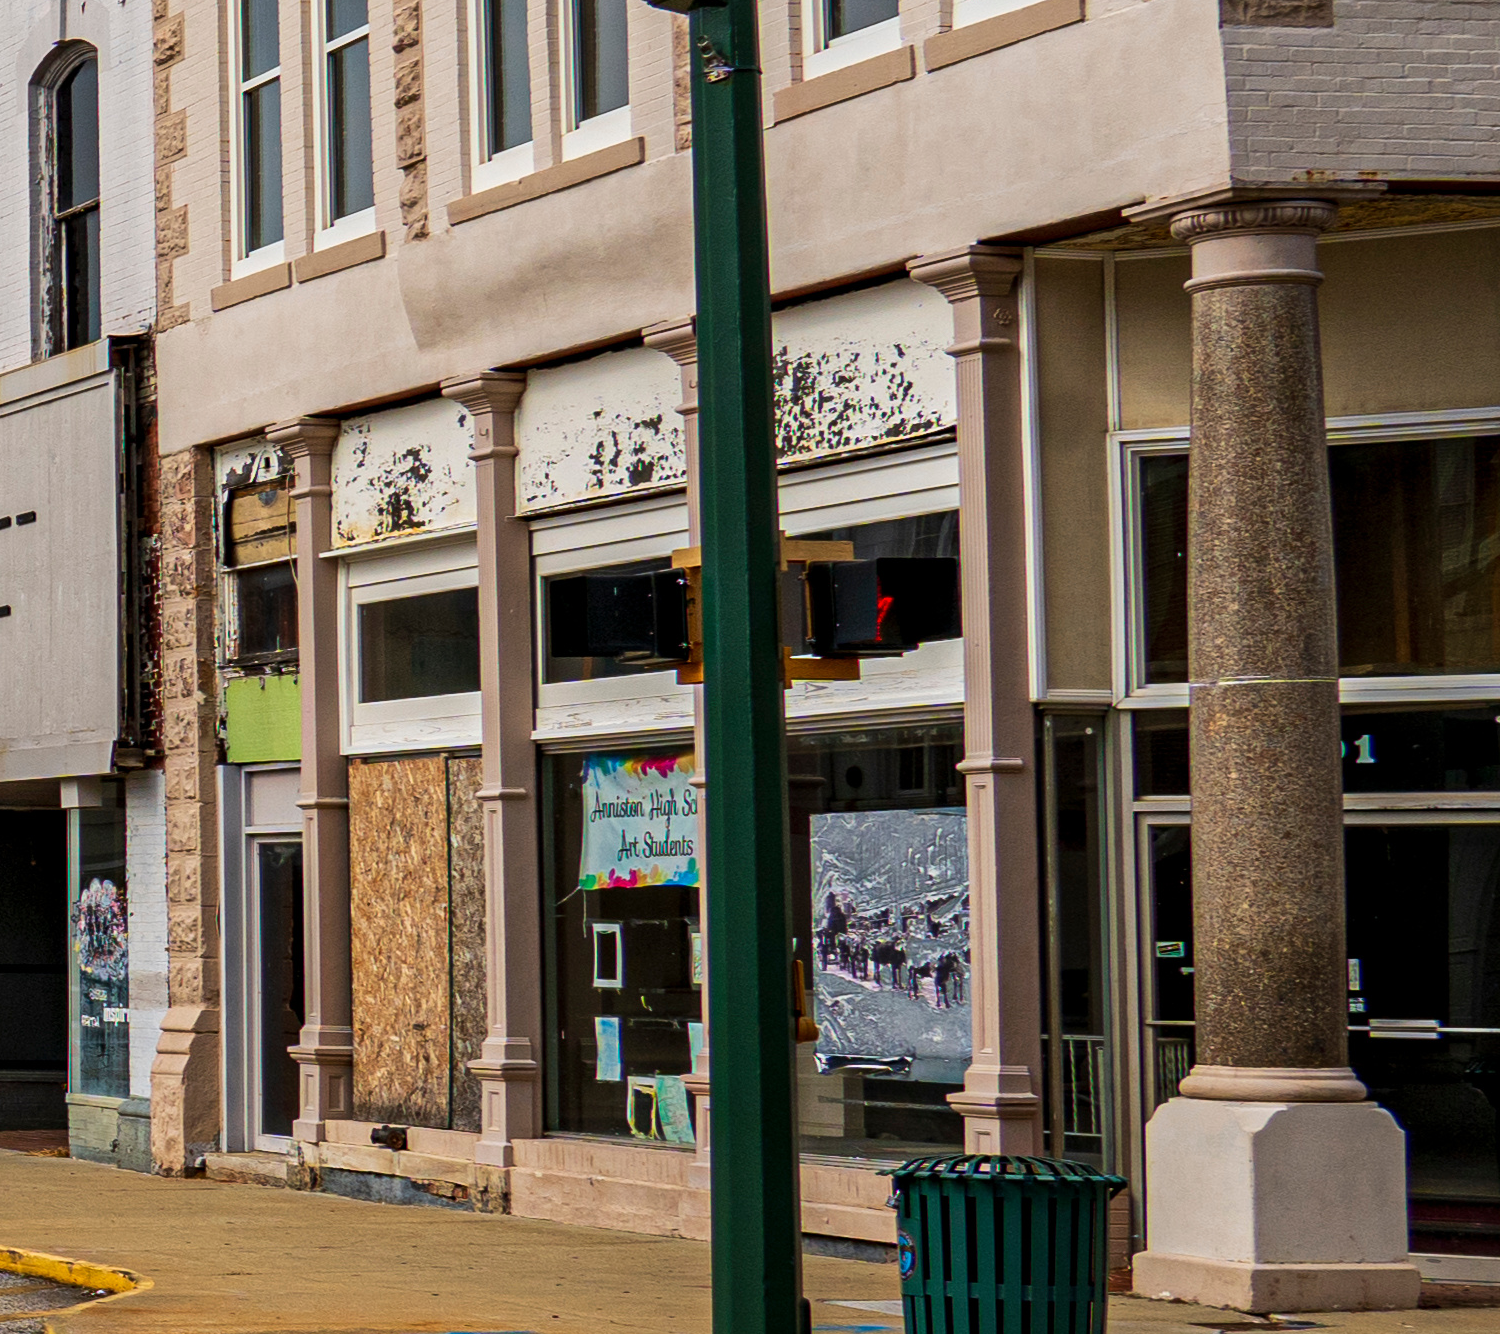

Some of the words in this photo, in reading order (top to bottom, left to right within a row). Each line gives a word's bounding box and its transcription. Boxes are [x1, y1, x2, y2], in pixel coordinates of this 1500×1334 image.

[589, 790, 644, 822] Anniston
[649, 788, 678, 829] High
[617, 829, 639, 862] Art
[642, 828, 694, 858] Students
